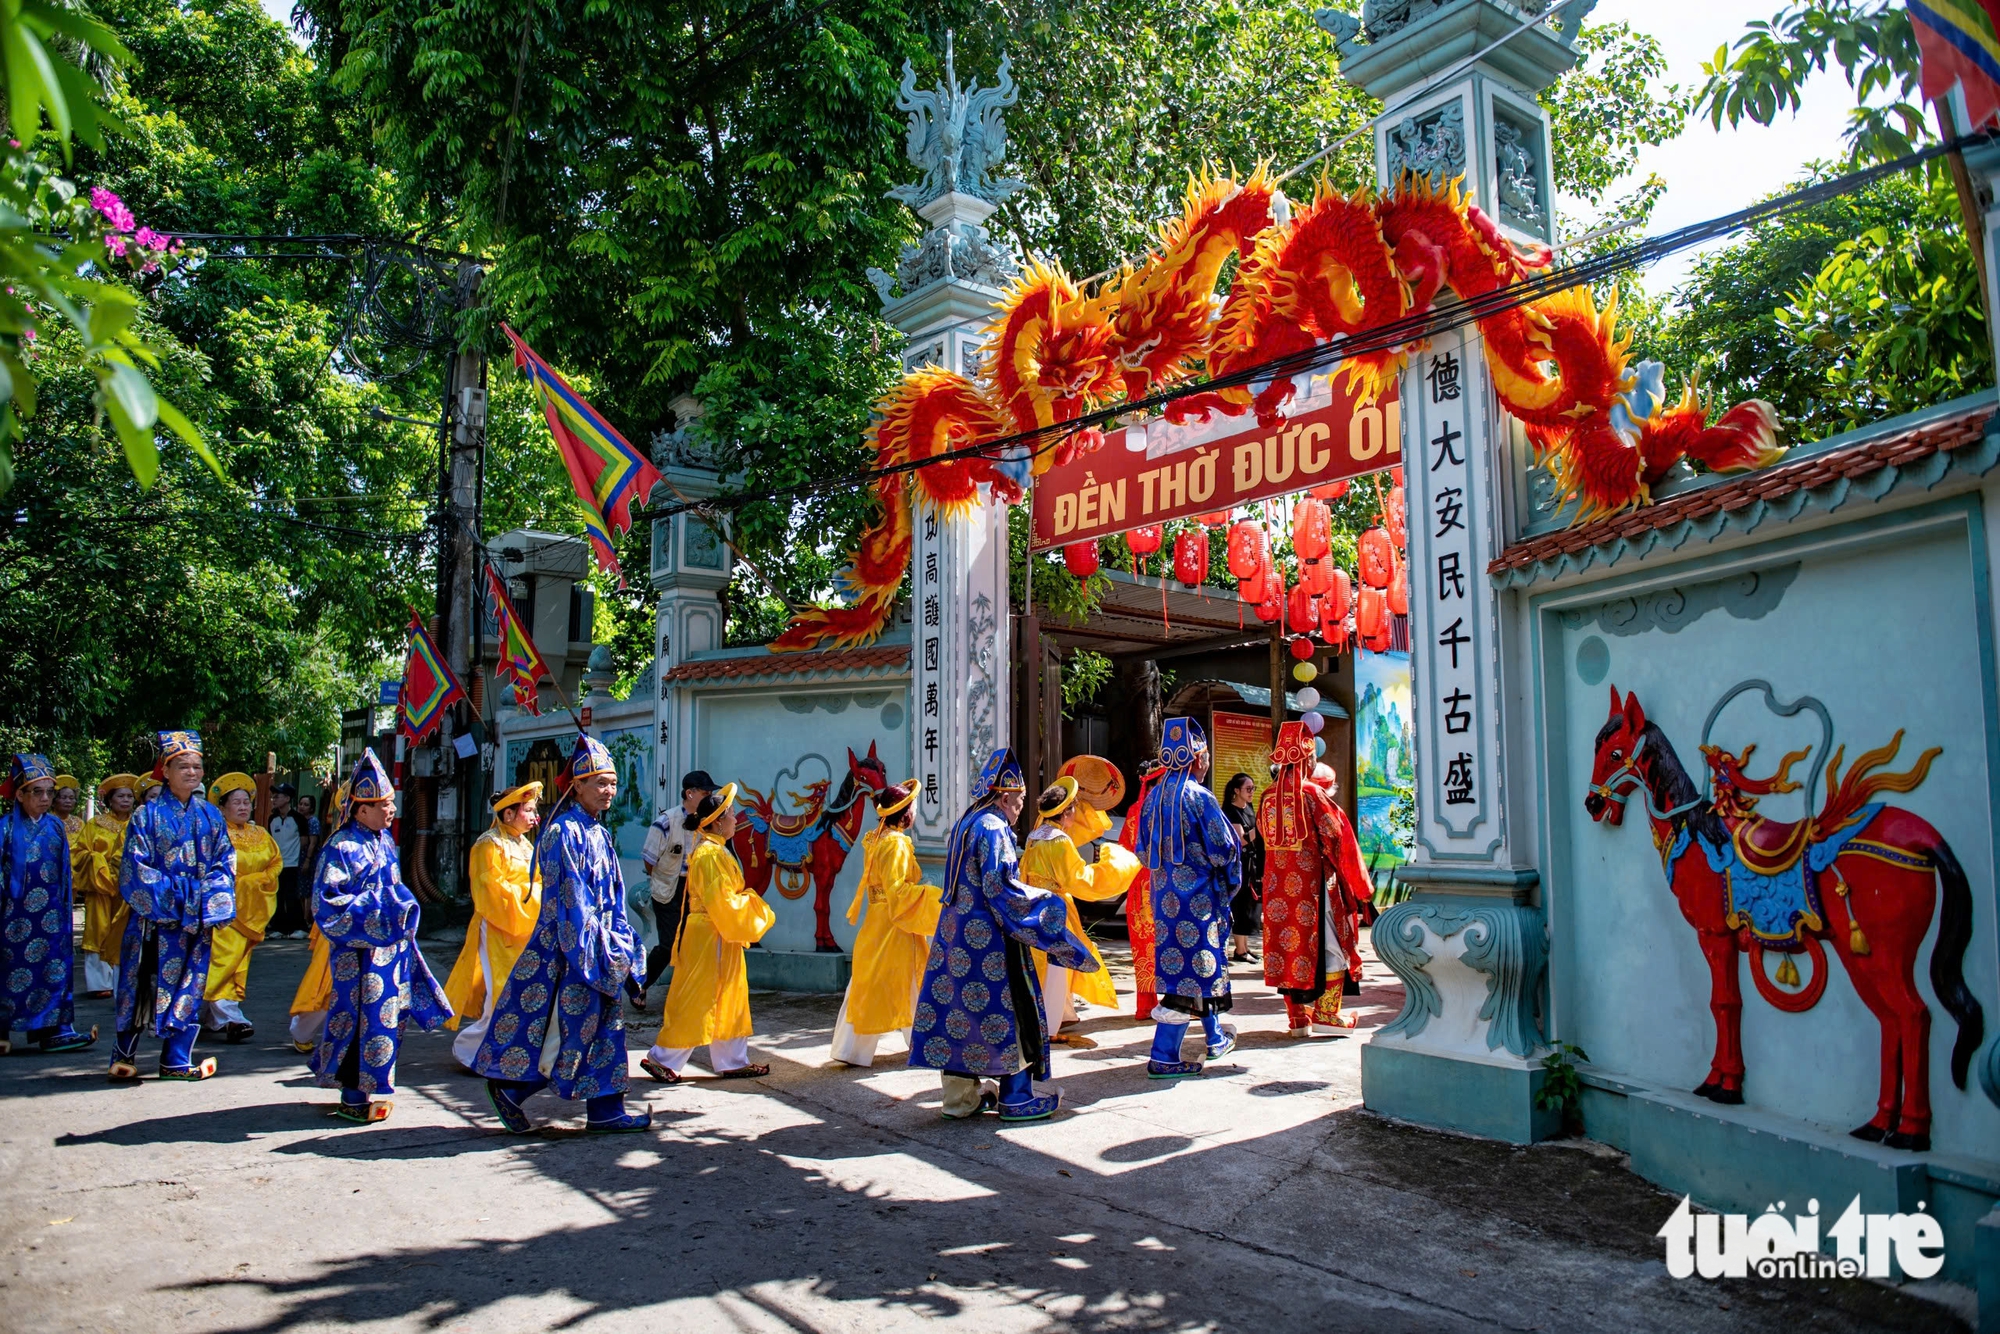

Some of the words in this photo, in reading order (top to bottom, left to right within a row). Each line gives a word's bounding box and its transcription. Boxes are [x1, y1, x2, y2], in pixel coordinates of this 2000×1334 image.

[1053, 470, 1127, 536] ĐỀN
[1137, 447, 1220, 515] THỜ
[1231, 420, 1331, 493] ĐỨC
[1425, 352, 1476, 804] 德大安民千古盛
